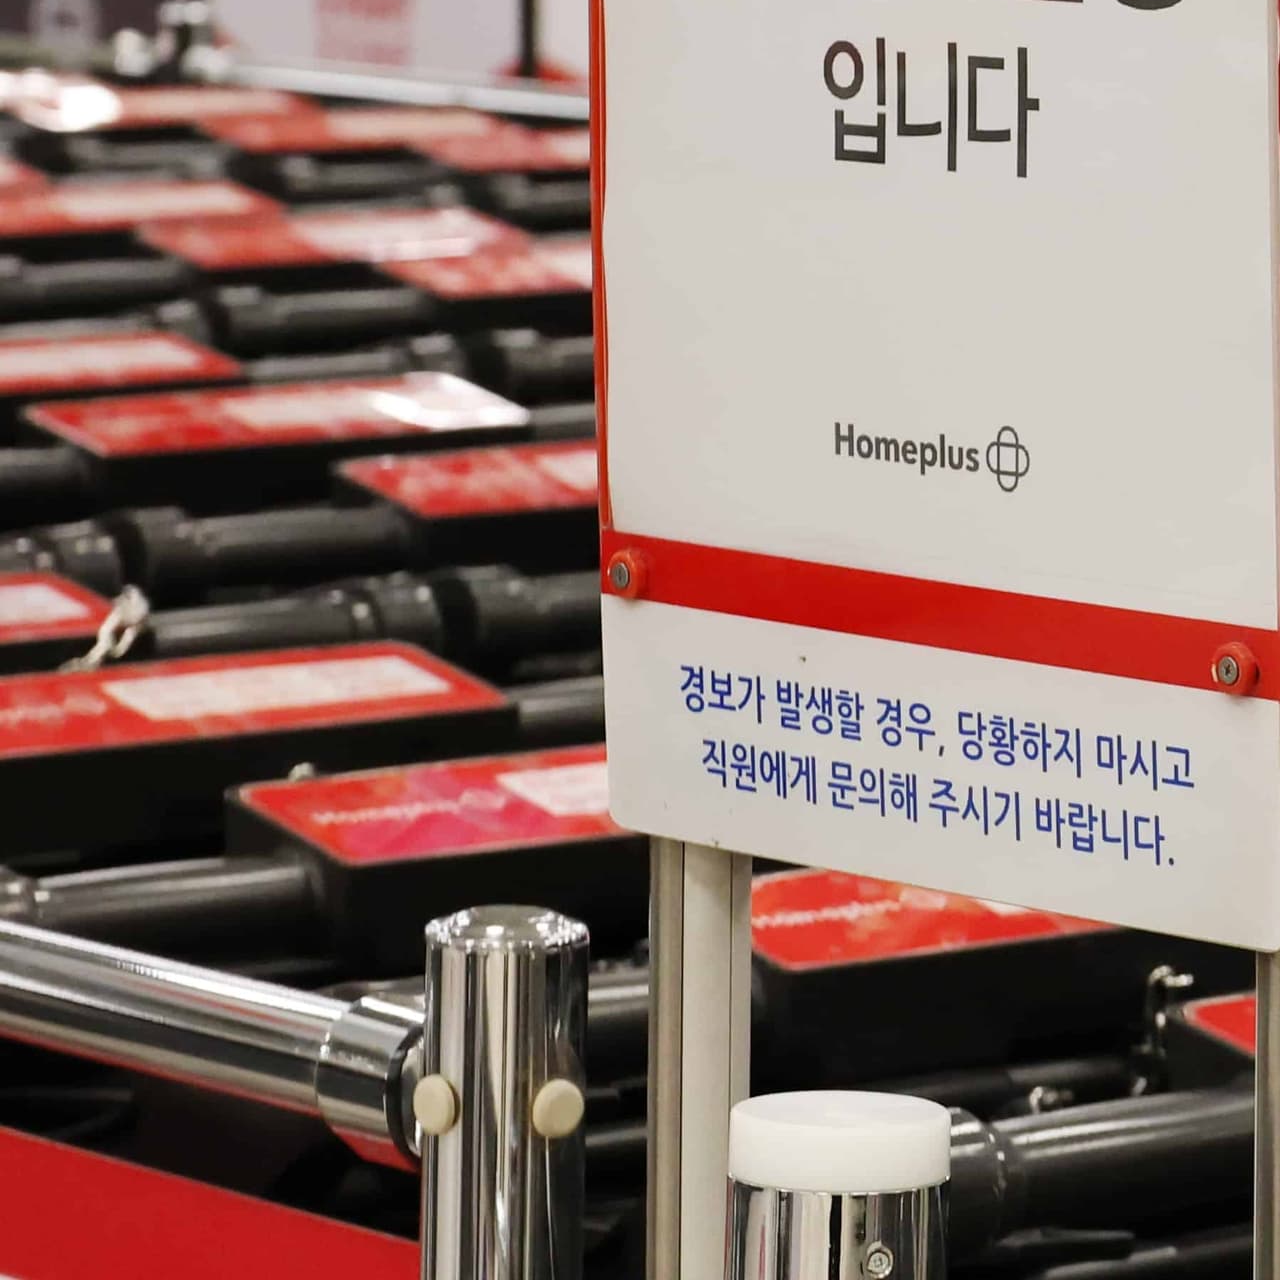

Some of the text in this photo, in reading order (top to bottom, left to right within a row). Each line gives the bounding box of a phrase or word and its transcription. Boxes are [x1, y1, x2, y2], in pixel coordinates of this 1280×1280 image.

[823, 37, 1040, 179] 입니다
[834, 422, 980, 476] Homeplus
[680, 665, 1196, 791] 경보가 발생할 경우, 당황하지 마시고
[701, 738, 1177, 868] 직원에게 문의해 주시기 바랍니다.
